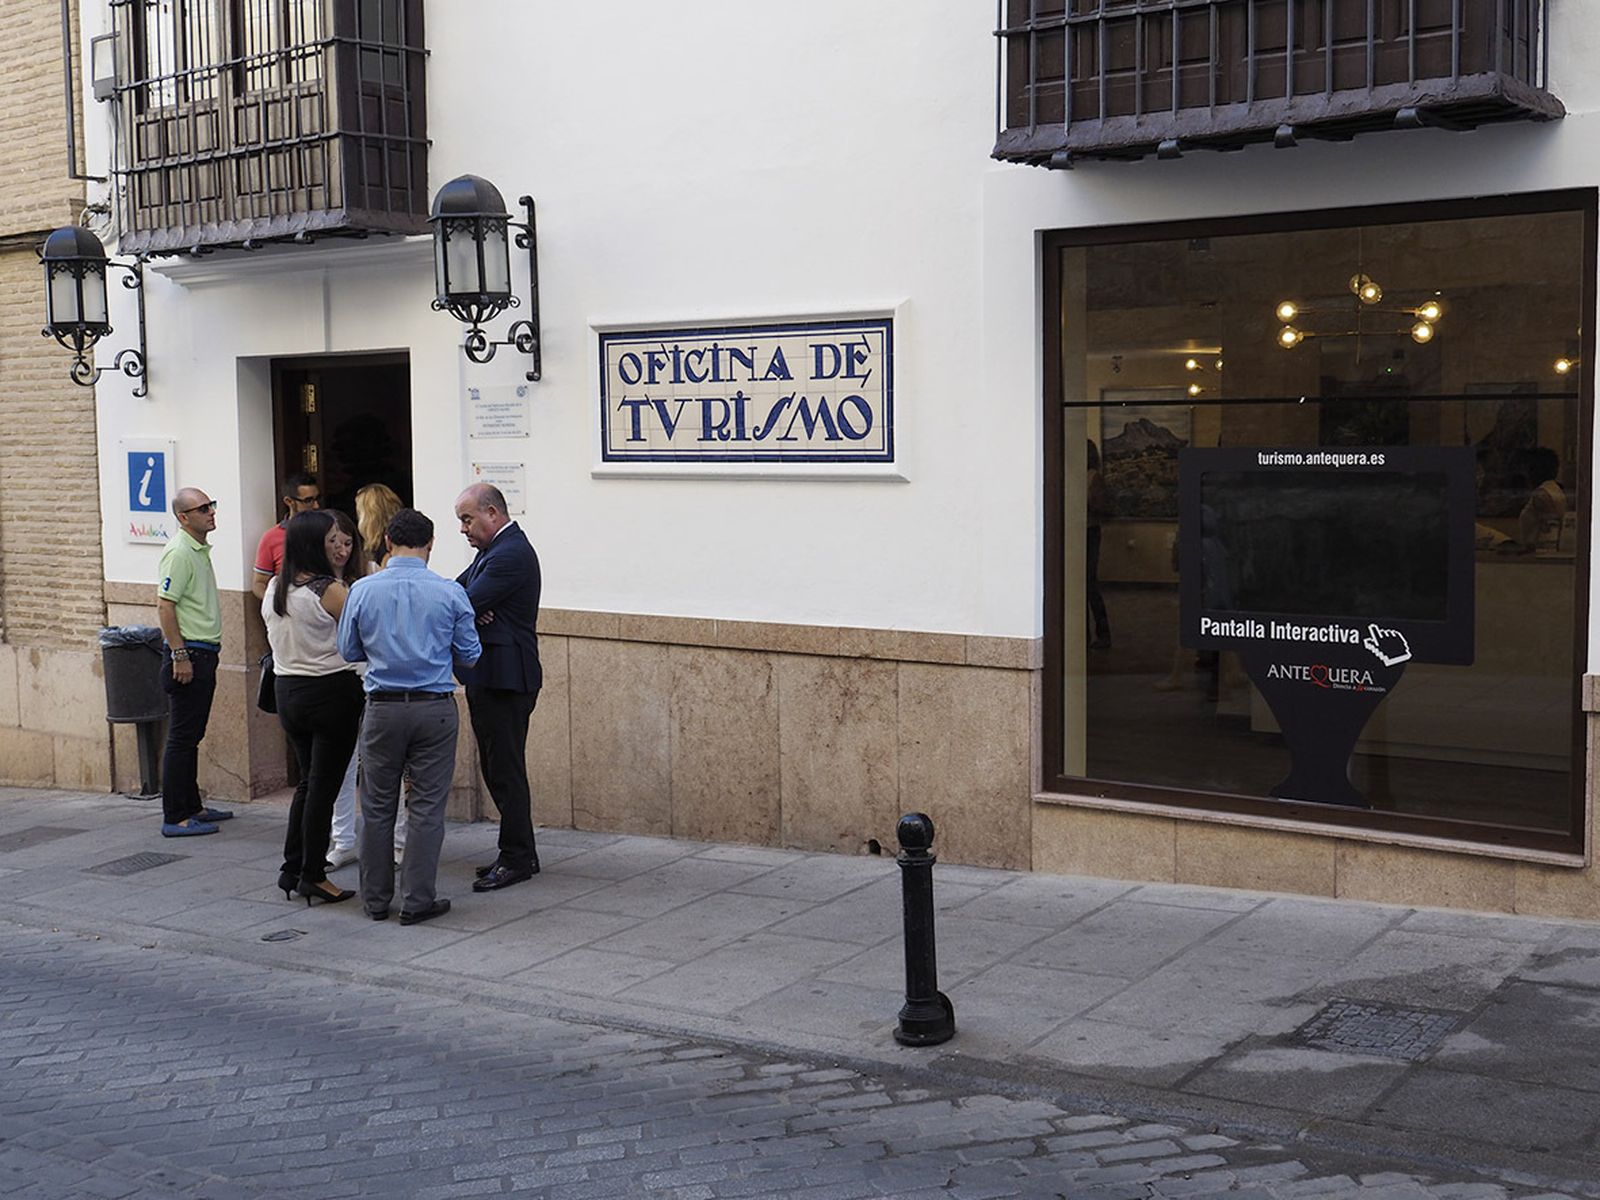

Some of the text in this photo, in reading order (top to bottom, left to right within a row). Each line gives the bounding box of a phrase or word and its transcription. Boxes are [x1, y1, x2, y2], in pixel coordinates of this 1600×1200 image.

[618, 334, 872, 388] OFICINA DE
[1258, 451, 1386, 468] turismo.antequera.es
[1200, 617, 1361, 645] Pantalla Interactiva
[1266, 664, 1374, 688] ANTEQUERA
